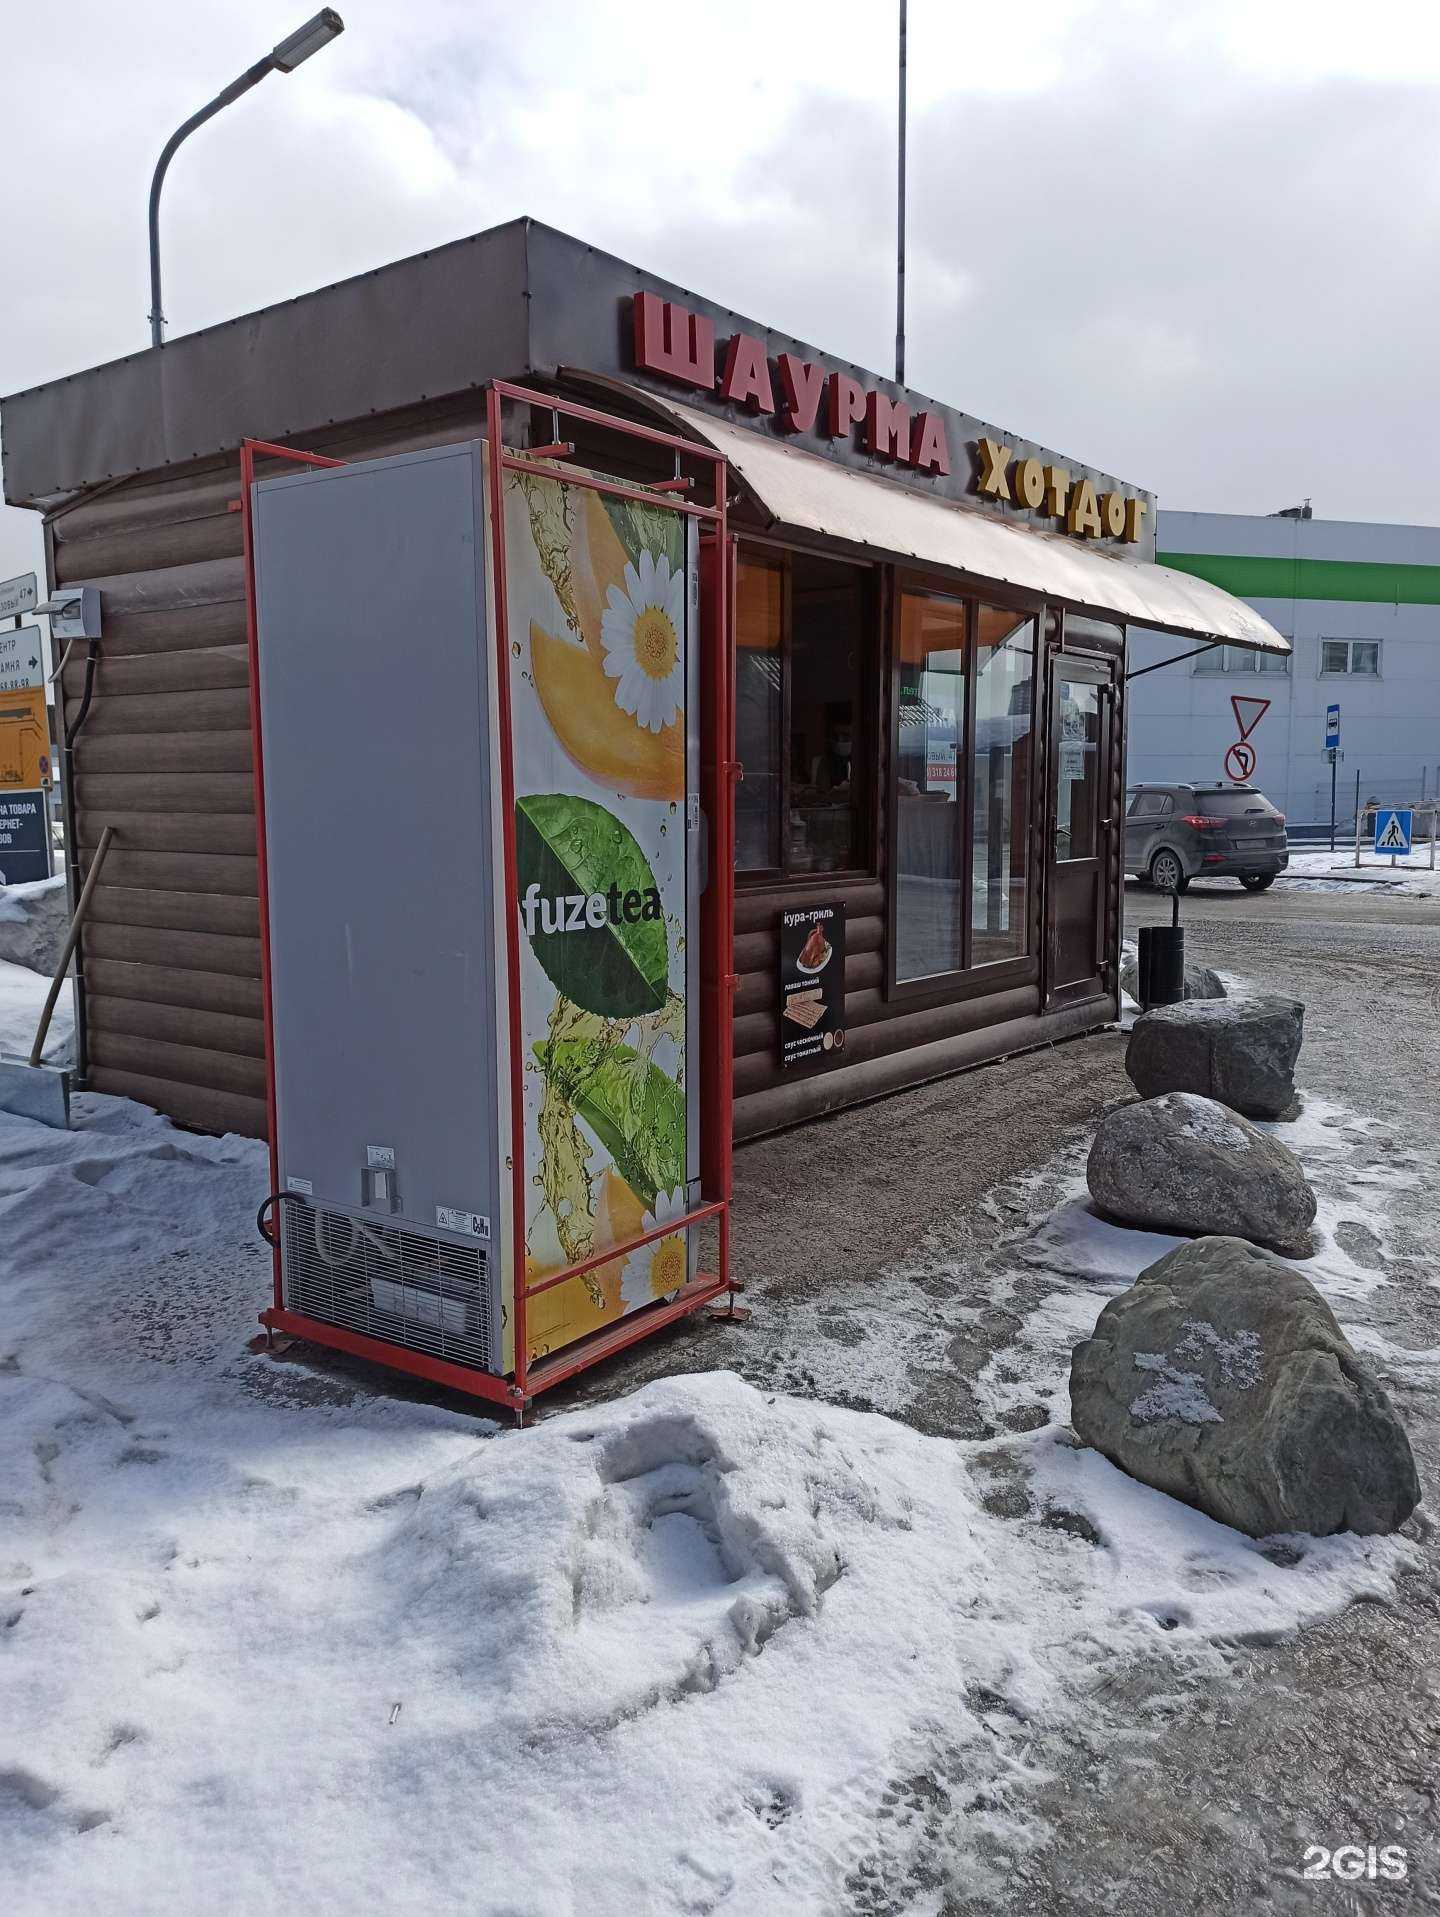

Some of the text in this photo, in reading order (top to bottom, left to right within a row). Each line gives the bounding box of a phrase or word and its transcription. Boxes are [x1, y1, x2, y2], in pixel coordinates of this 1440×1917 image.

[634, 291, 950, 476] ШАУРМА
[8, 803, 37, 815] ТОВАРА
[784, 909, 834, 927] кура-гриль
